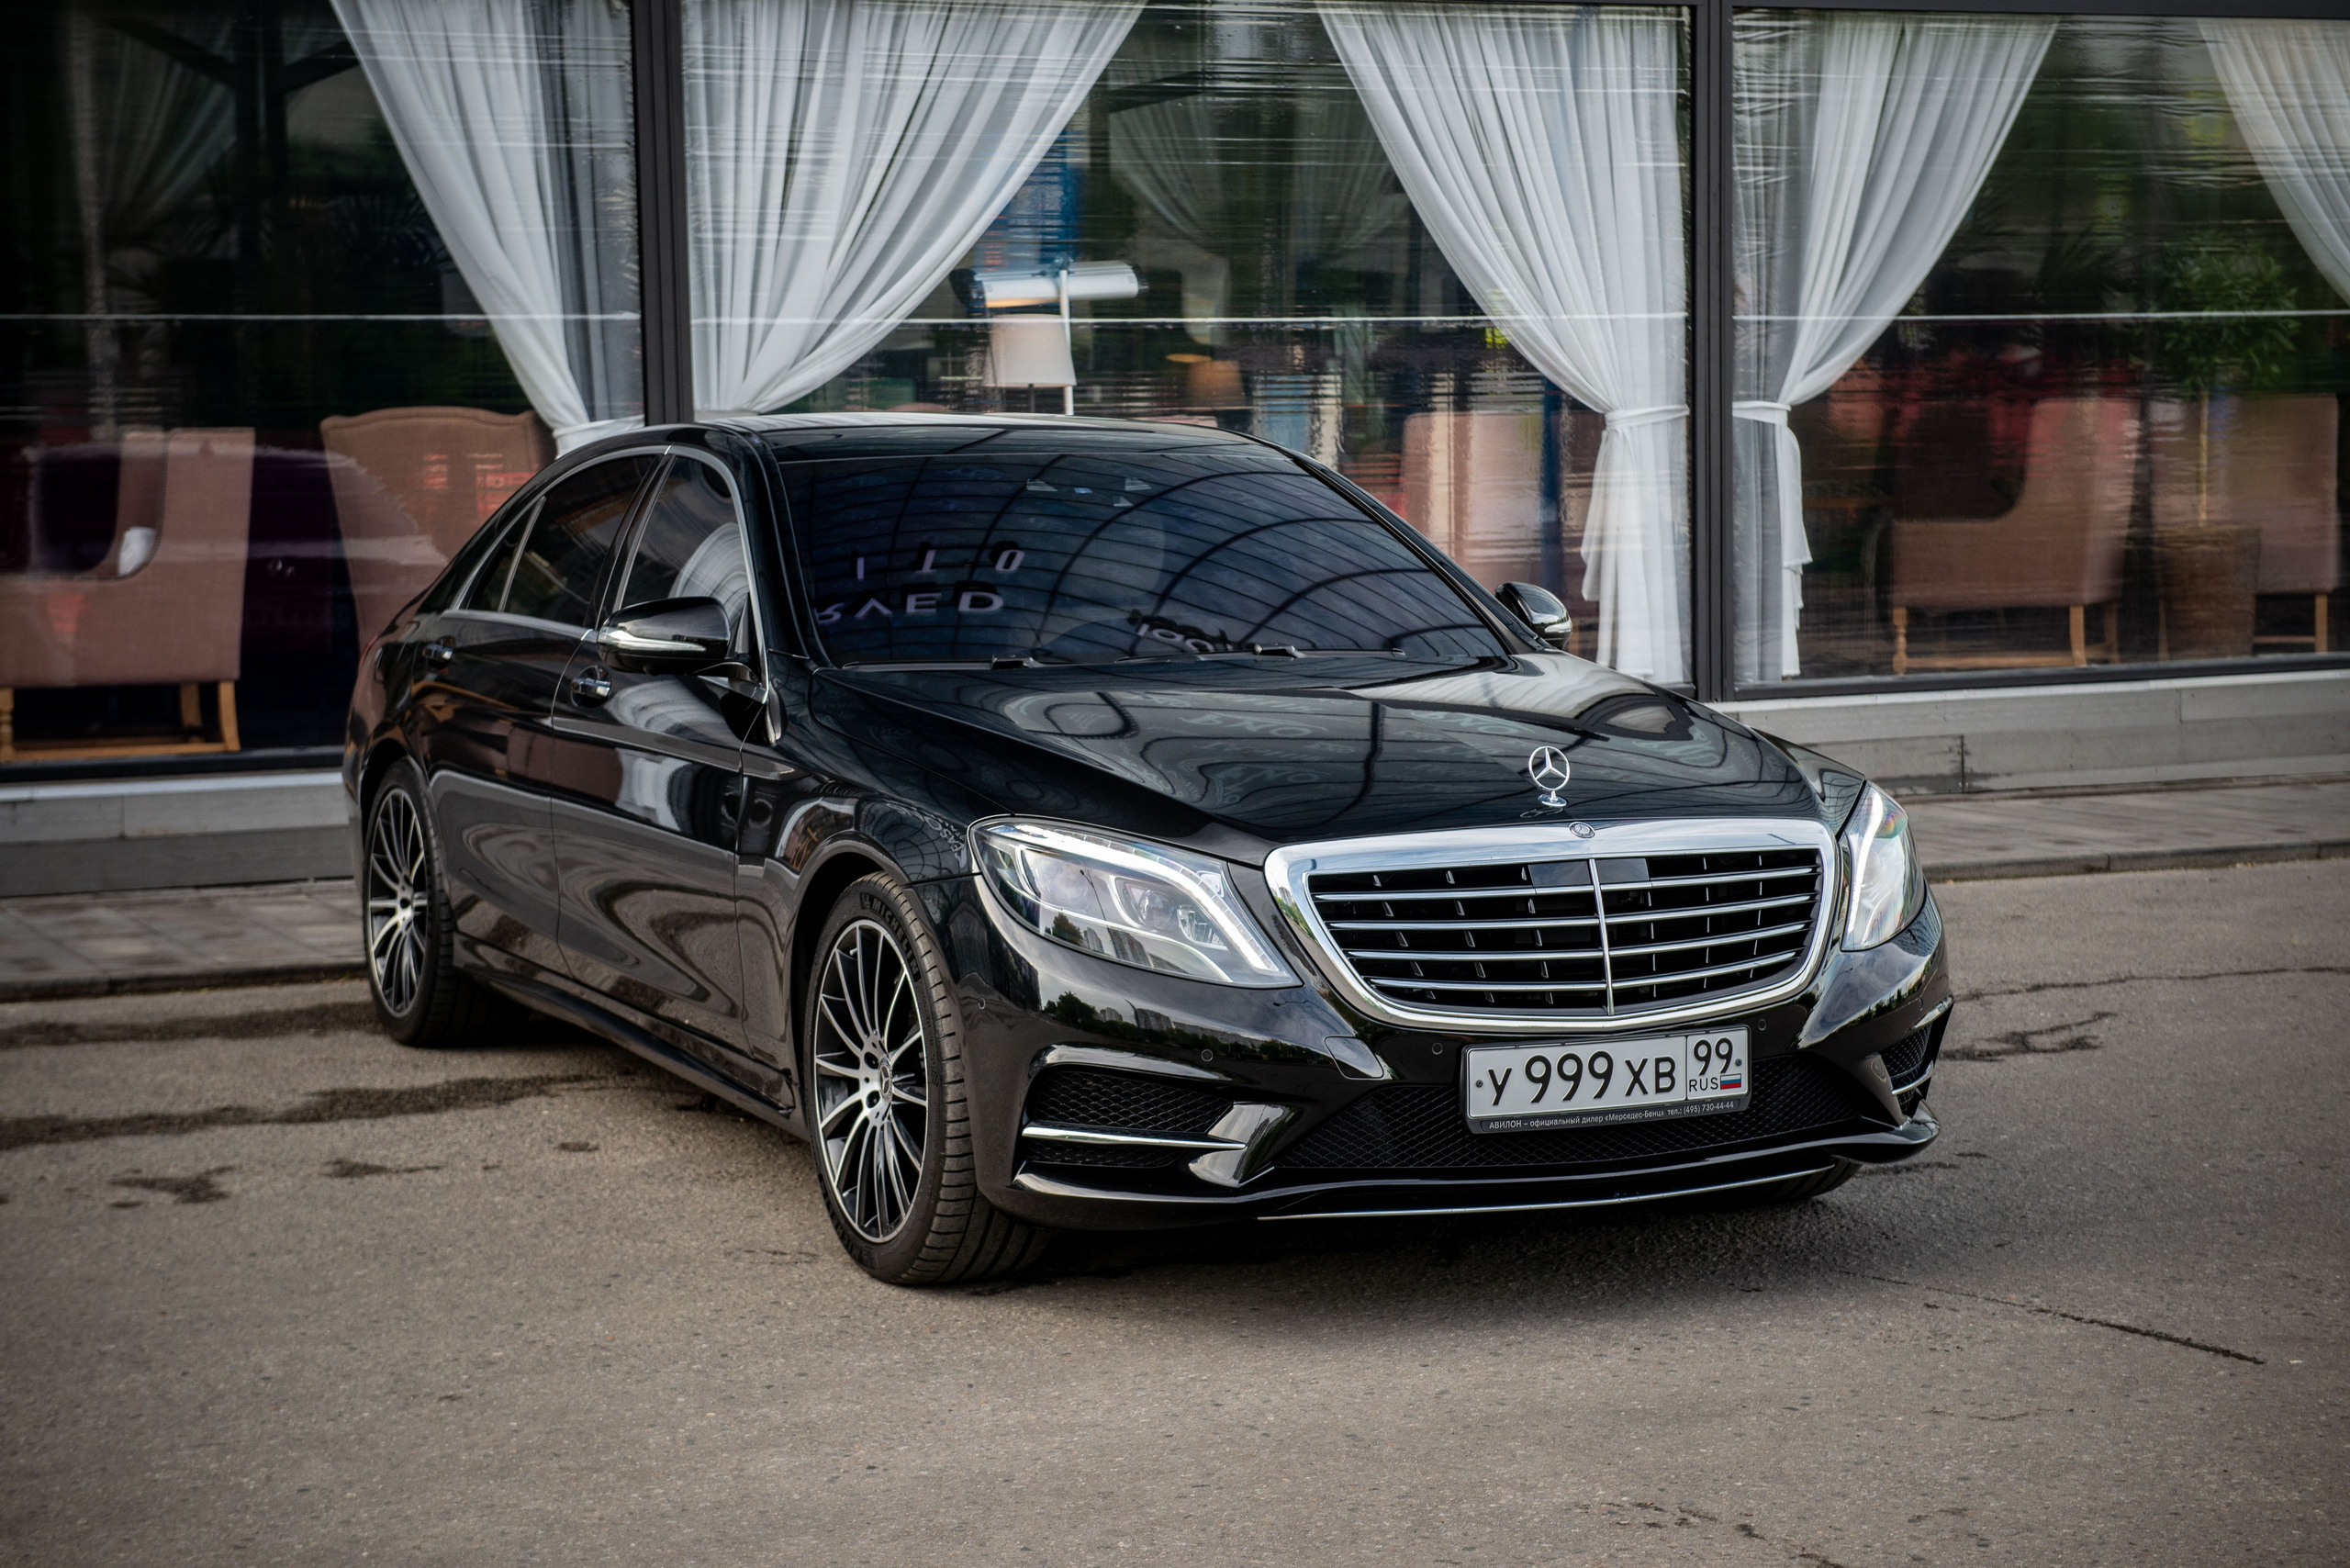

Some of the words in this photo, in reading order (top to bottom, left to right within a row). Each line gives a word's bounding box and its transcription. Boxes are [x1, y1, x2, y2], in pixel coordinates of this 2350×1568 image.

[872, 898, 919, 974] MICHELIN
[1694, 1036, 1733, 1076] 99
[1689, 1077, 1718, 1092] RUS
[1489, 1119, 1521, 1129] АВИЛОН
[1529, 1116, 1580, 1128] официальный
[1582, 1114, 1603, 1125] дилер
[1684, 1106, 1701, 1115] (495)
[1702, 1101, 1734, 1112] 730-44-44
